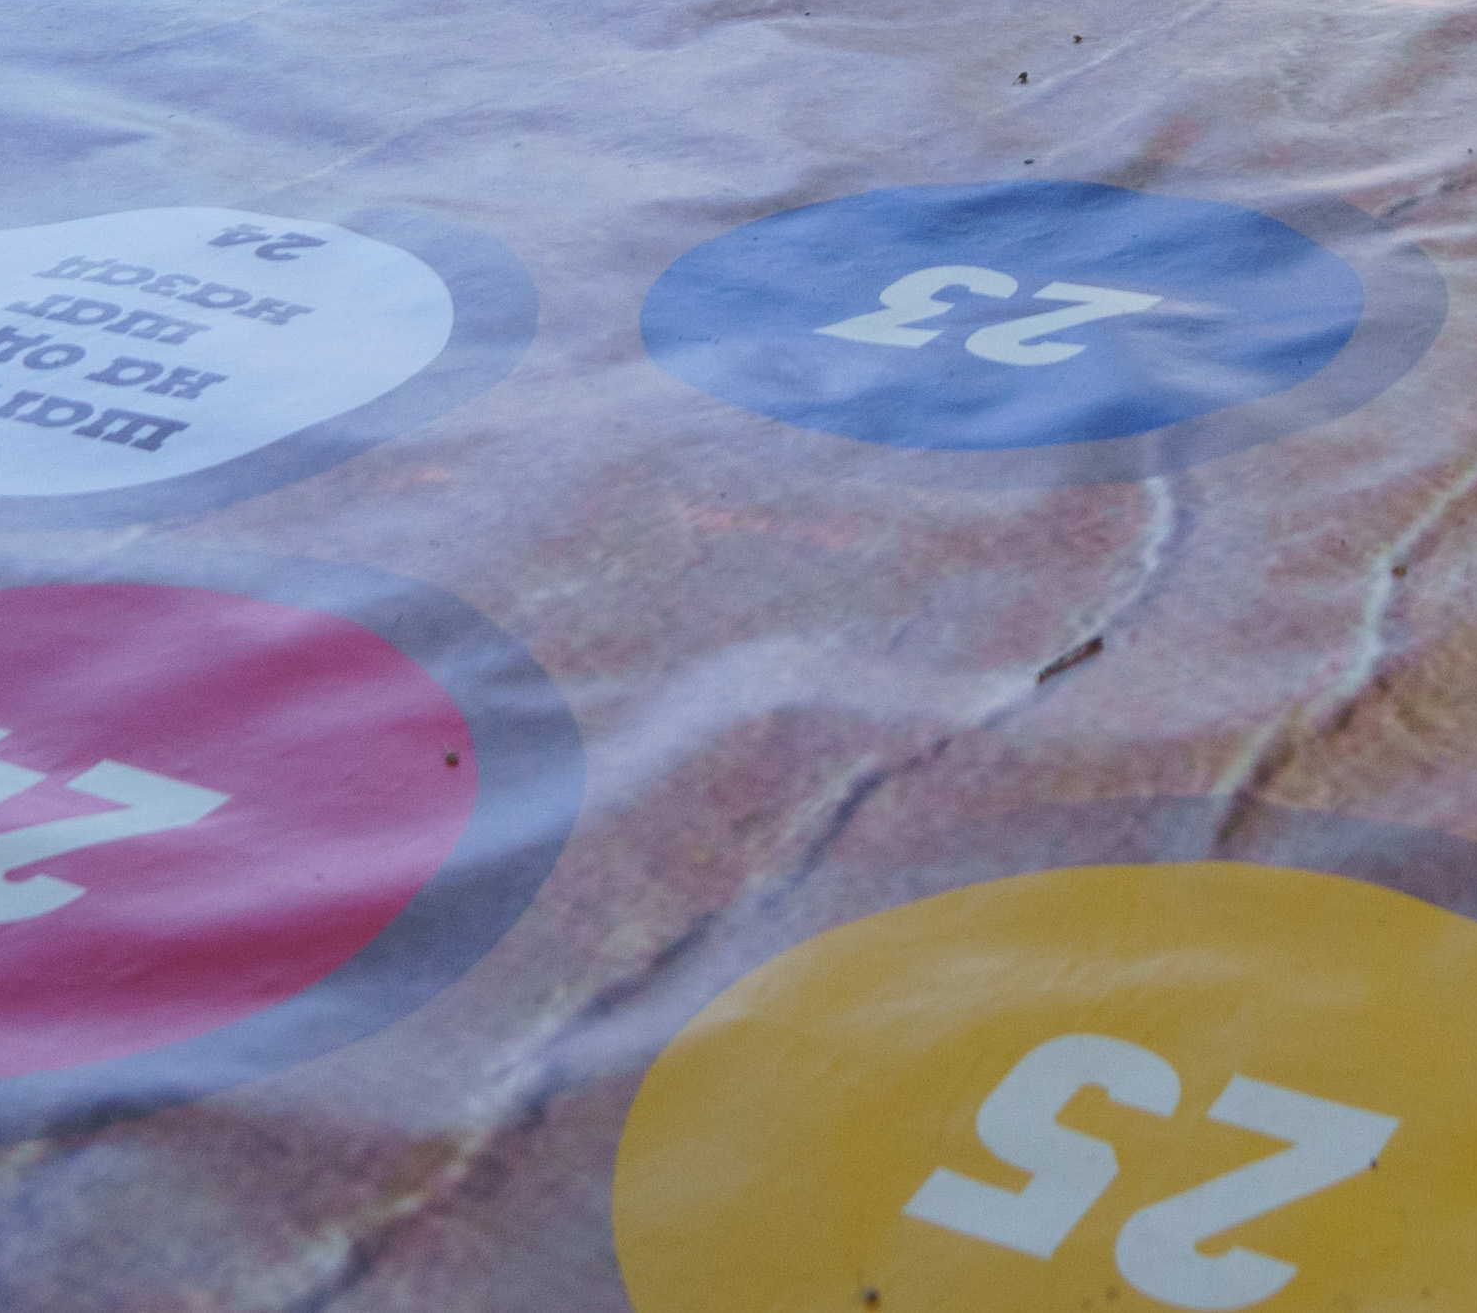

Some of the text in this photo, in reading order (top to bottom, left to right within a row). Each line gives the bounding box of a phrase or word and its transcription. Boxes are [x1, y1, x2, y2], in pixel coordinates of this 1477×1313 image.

[207, 223, 329, 263] 24
[0, 293, 212, 346] шаг
[31, 255, 316, 326] назад
[813, 264, 1165, 367] 23
[84, 358, 229, 400] на
[901, 1031, 1402, 1310] 25
